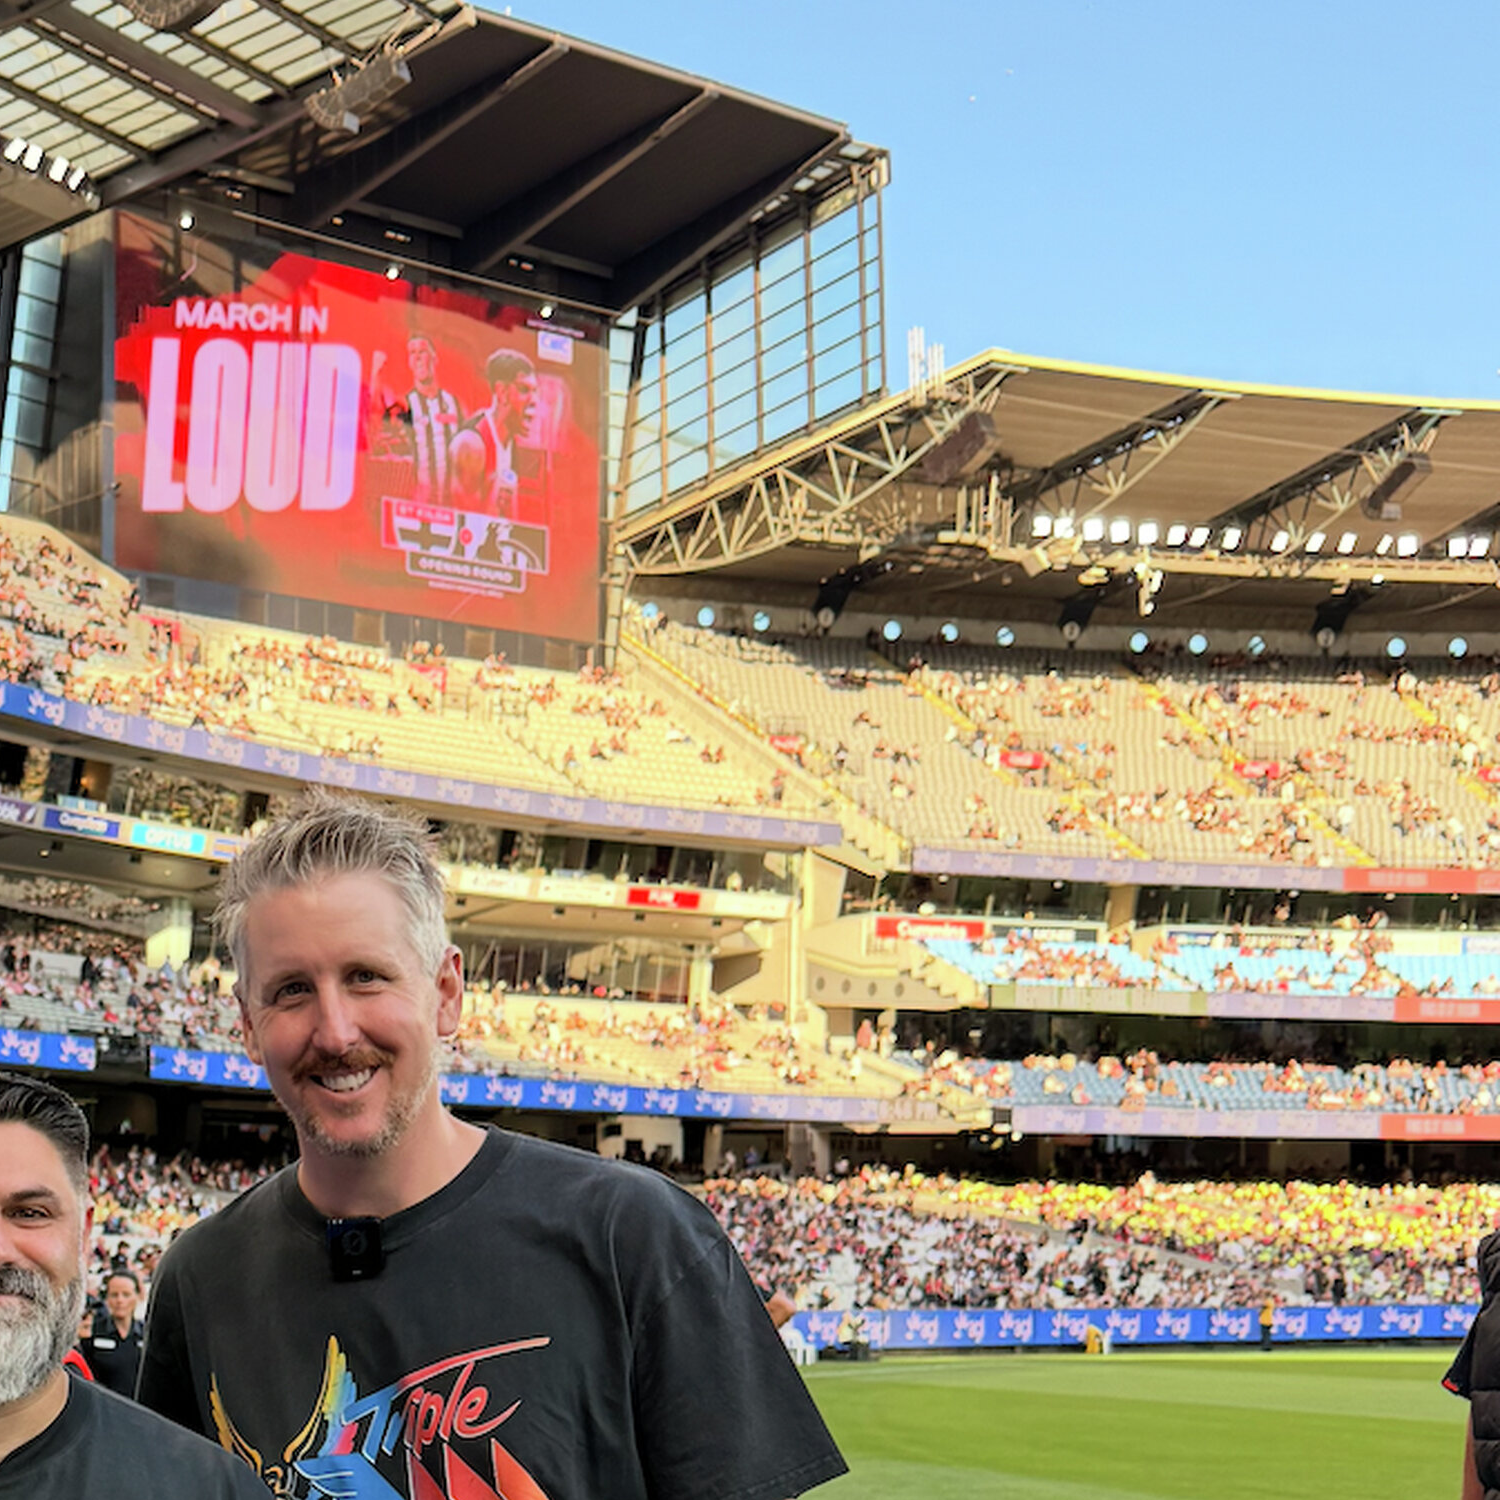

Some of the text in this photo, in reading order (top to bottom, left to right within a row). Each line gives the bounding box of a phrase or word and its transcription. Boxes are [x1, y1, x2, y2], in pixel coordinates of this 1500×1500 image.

[175, 298, 329, 334] MARCH IN
[142, 337, 363, 513] LOUD
[43, 700, 66, 726] agl
[145, 827, 192, 851] OPTUS
[19, 1037, 41, 1064] agl
[187, 1055, 208, 1081] agl
[502, 1081, 523, 1106] agl
[919, 1314, 940, 1345] agl
[967, 1314, 986, 1344] agl
[1014, 1313, 1034, 1343] agl
[1120, 1313, 1141, 1340] agl
[1170, 1313, 1191, 1340] agl
[1227, 1313, 1250, 1340] agl
[1285, 1311, 1308, 1338] agl
[1340, 1310, 1364, 1337] agl
[1398, 1310, 1423, 1337] agl
[341, 1336, 551, 1463] Triple
